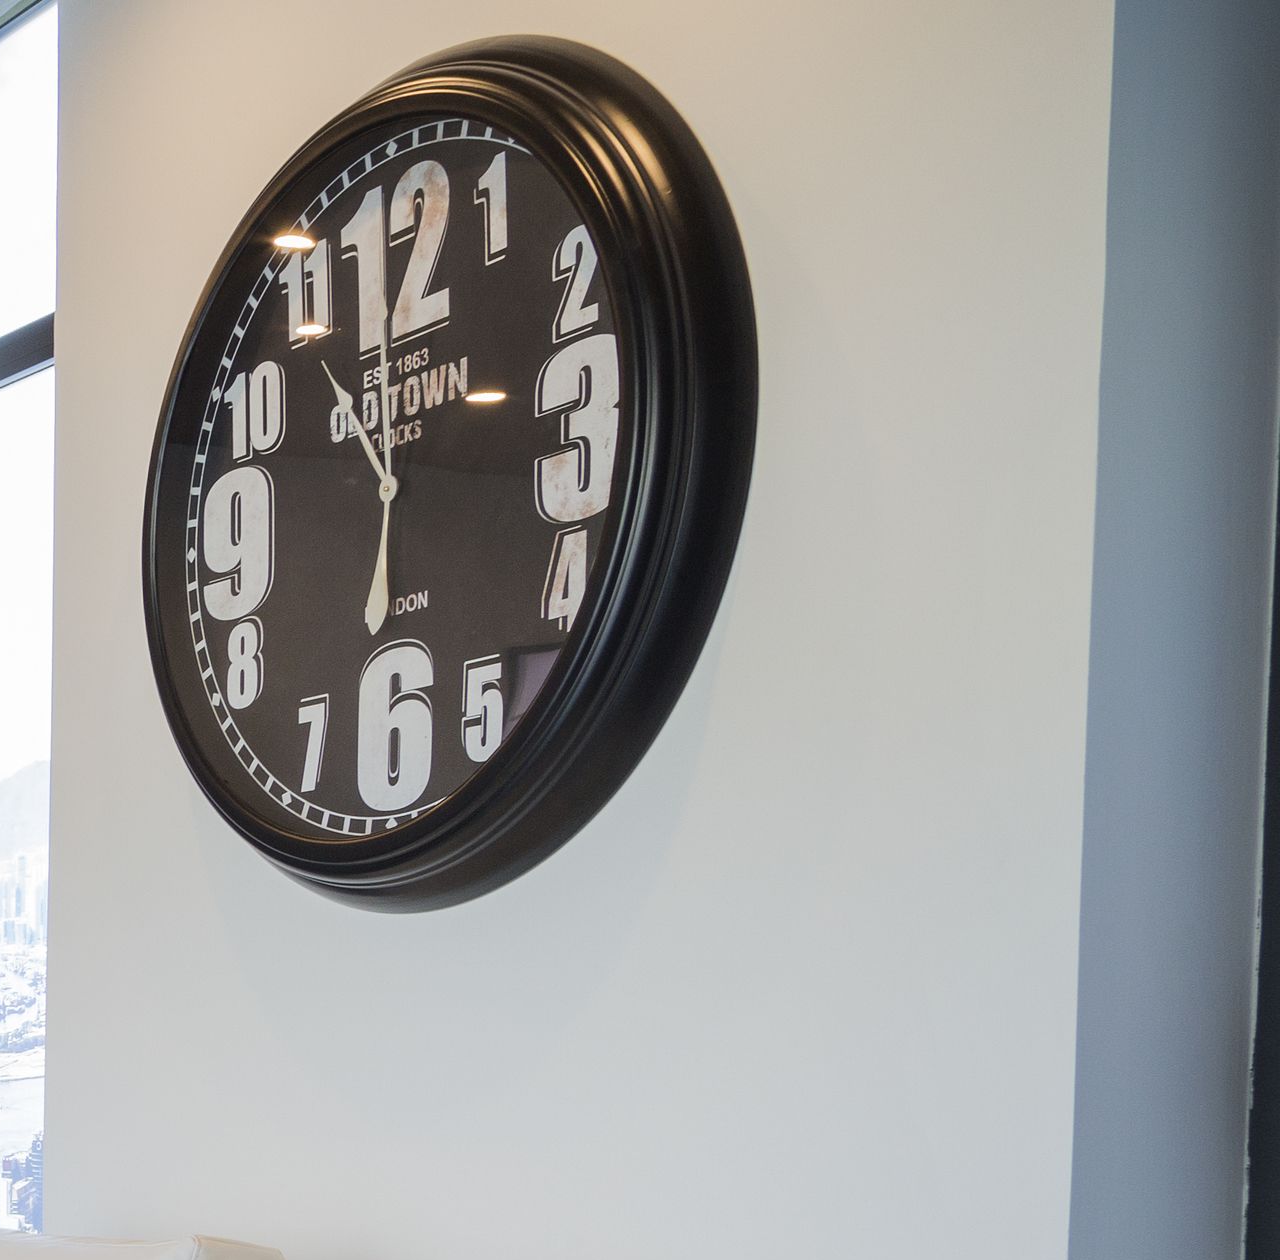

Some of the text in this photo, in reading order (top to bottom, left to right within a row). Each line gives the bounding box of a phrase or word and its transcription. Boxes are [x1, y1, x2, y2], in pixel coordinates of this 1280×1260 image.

[340, 160, 450, 359] 12
[474, 151, 508, 266] 1
[278, 238, 332, 350] 11
[552, 224, 599, 344] 2
[223, 360, 285, 462] 10
[387, 356, 468, 421] TOWN
[396, 347, 429, 375] 1863
[535, 333, 620, 524] 3
[203, 465, 275, 621] 9
[541, 525, 587, 632] 4
[227, 616, 264, 710] 8
[461, 653, 504, 763] 5
[298, 693, 329, 793] 7
[357, 638, 434, 812] 6
